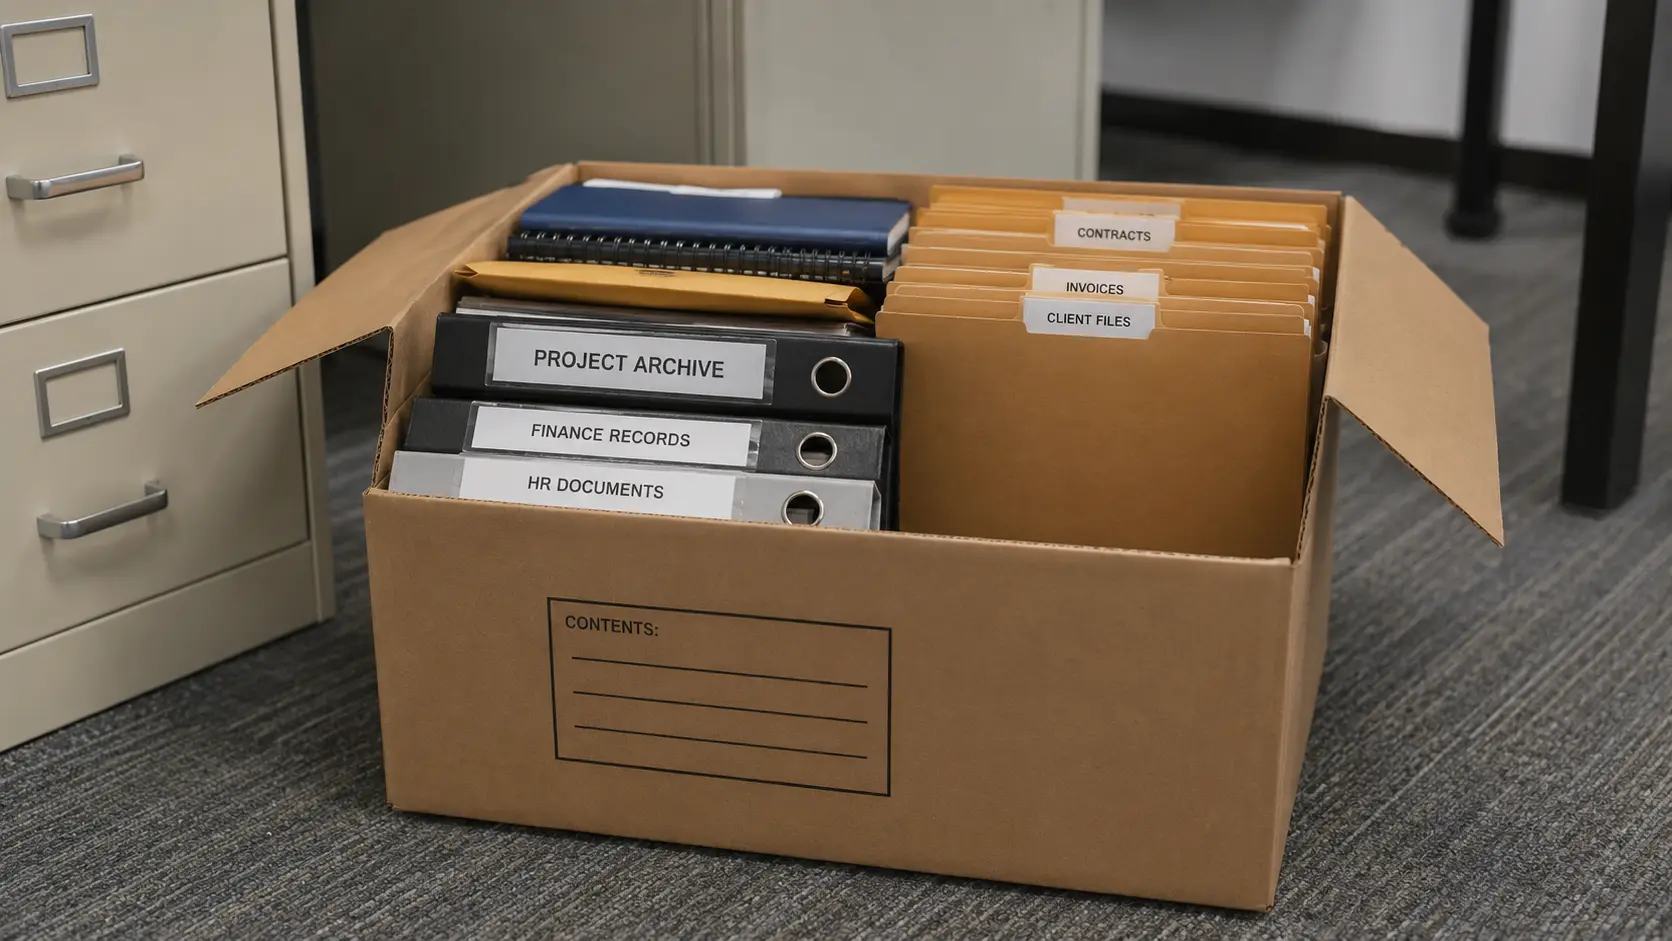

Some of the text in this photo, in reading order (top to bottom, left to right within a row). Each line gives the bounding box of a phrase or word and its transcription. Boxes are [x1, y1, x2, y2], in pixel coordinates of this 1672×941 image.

[1077, 227, 1152, 242] CONTRACTS
[1065, 281, 1124, 295] INVOICES
[1047, 312, 1131, 328] CLIENT FILES
[533, 349, 725, 379] PROJECT ARCHIVE
[531, 423, 691, 448] FINANCE RECORDS
[527, 475, 664, 499] HR DOCUMENTS
[565, 615, 659, 637] CONTENTS:
